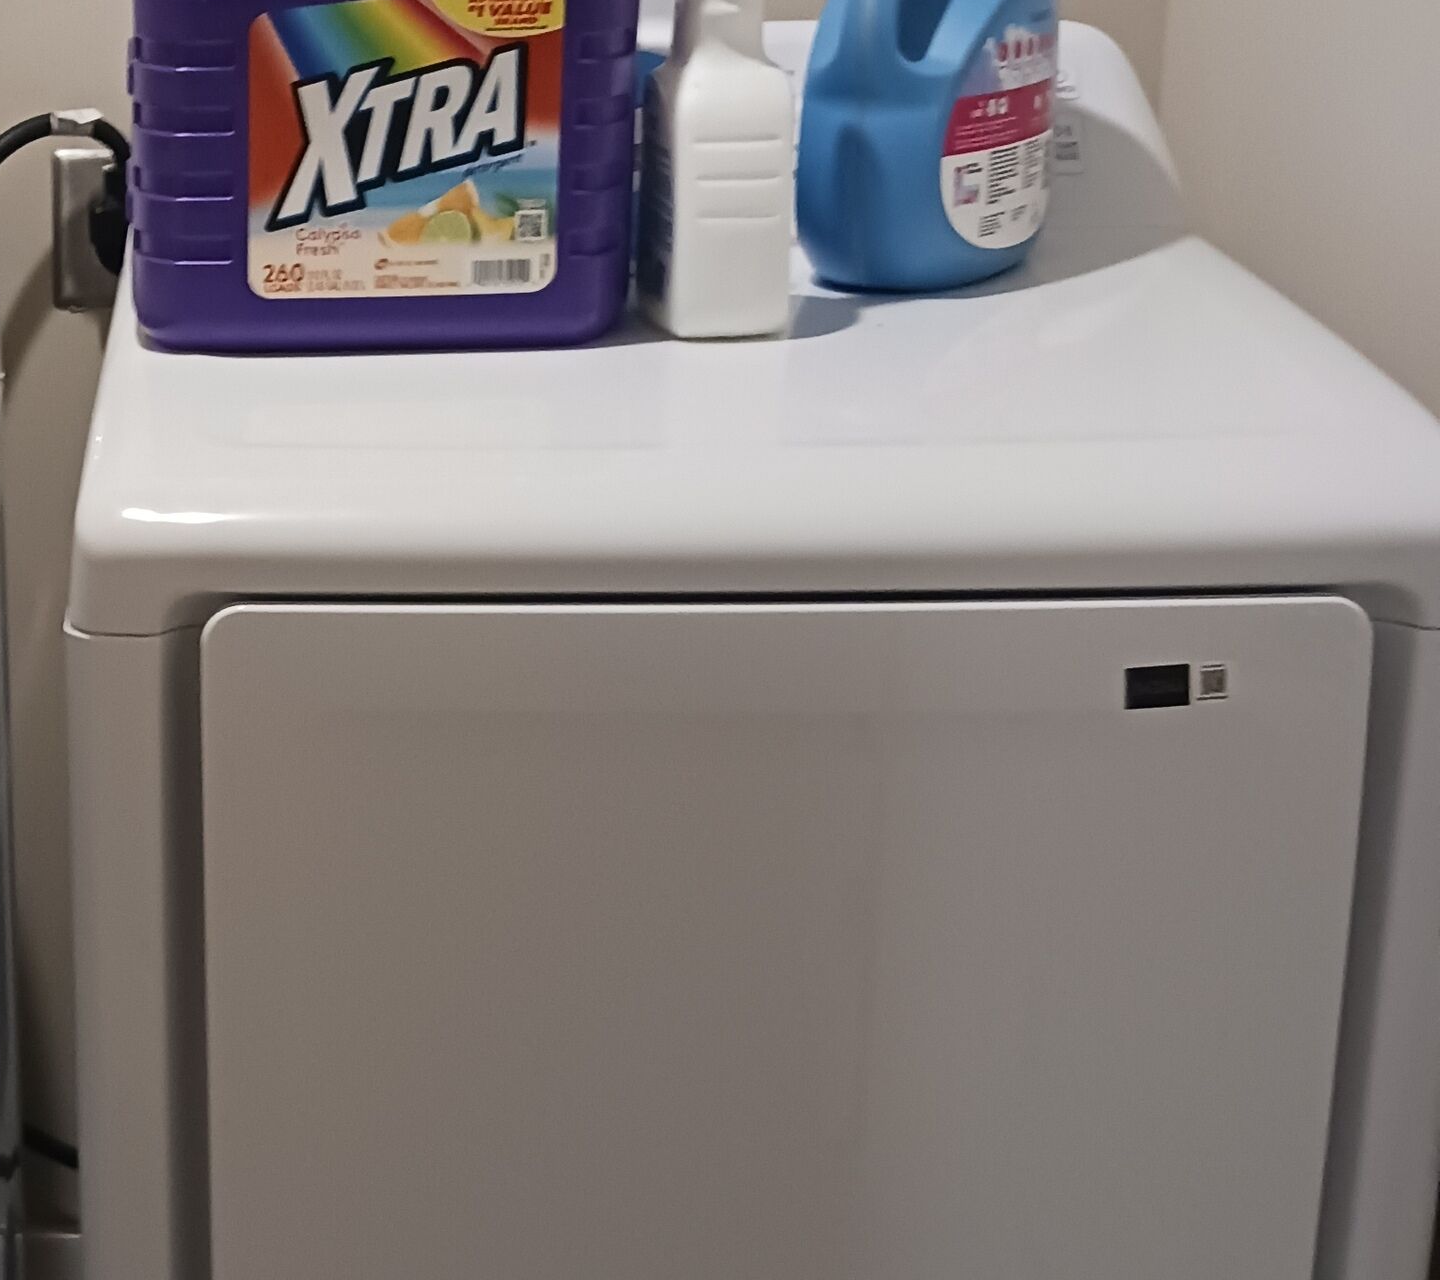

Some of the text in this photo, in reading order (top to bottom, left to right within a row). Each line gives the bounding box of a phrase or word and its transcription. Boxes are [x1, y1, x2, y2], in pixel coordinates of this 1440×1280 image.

[488, 1, 552, 16] VALUE
[268, 43, 526, 229] XTRA
[263, 263, 304, 283] 260
